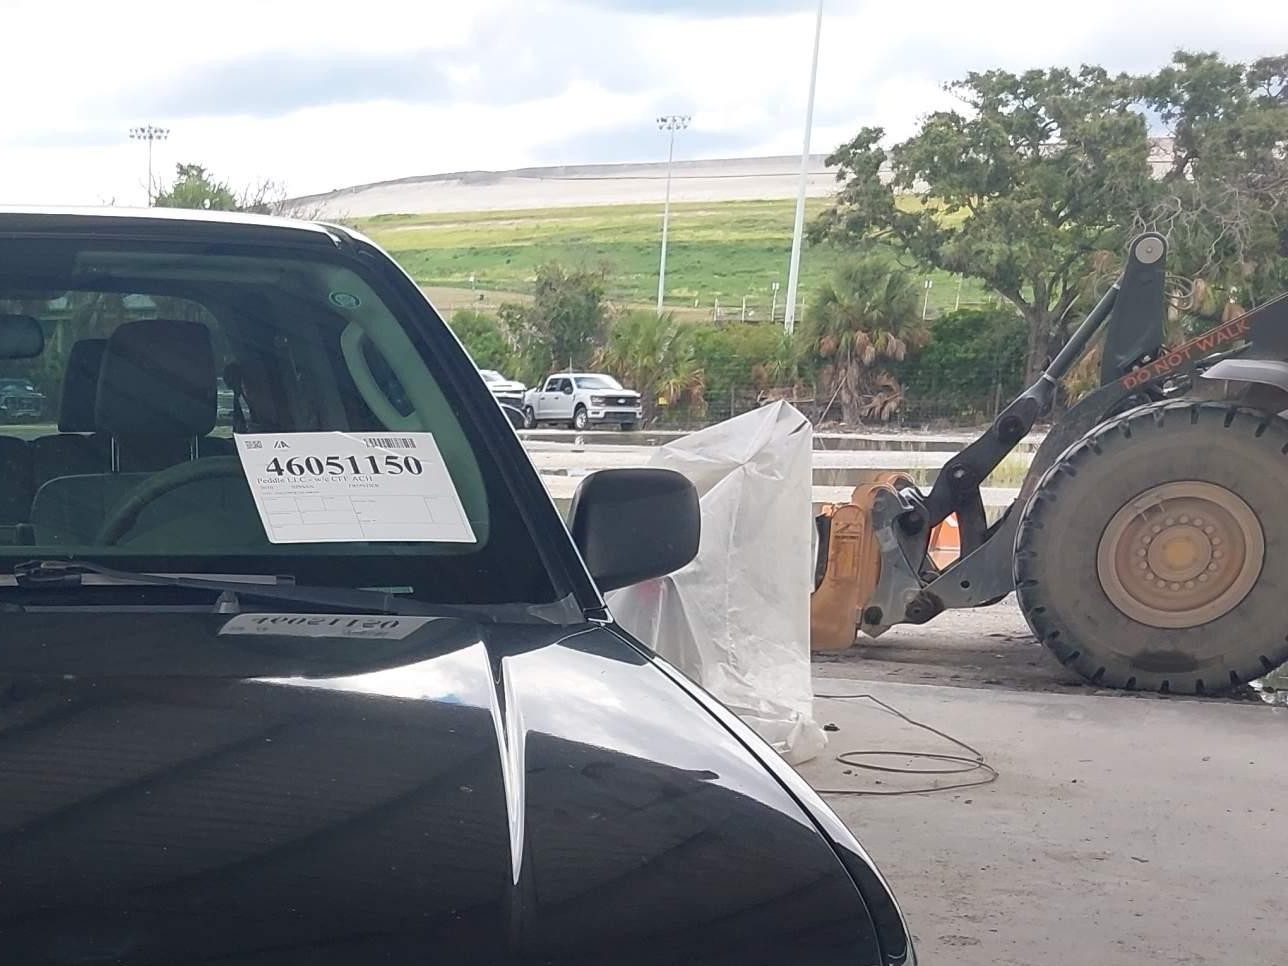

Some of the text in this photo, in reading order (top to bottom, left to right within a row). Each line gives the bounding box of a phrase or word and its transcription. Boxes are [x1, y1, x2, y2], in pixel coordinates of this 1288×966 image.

[1123, 320, 1251, 389] DO NOT WALK
[266, 455, 423, 476] 46051150
